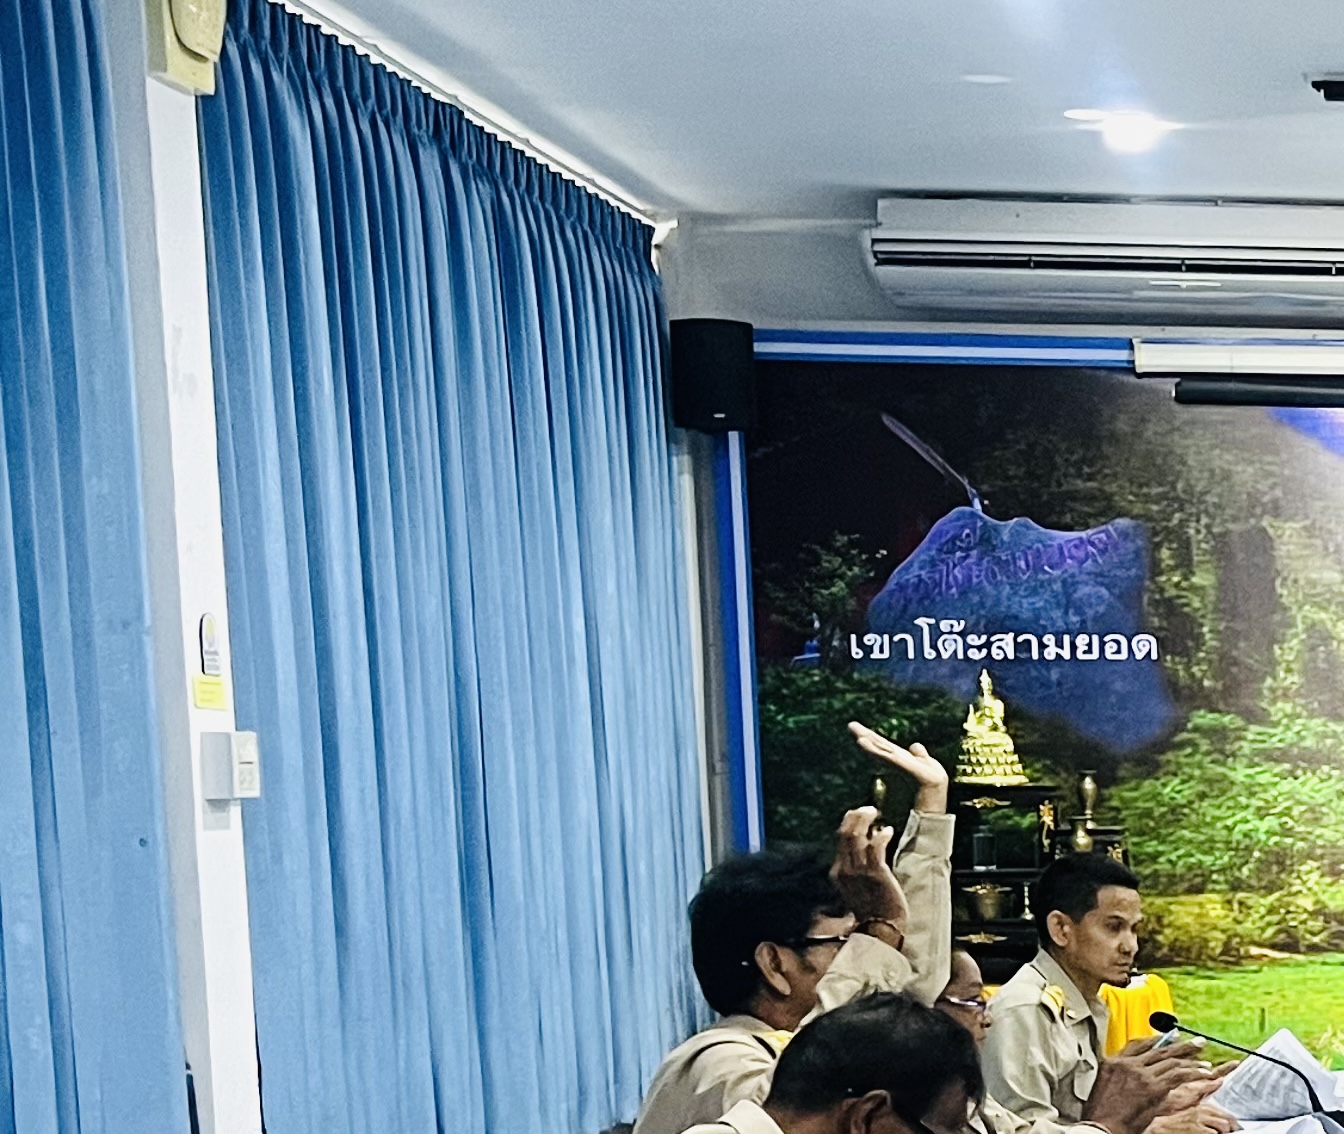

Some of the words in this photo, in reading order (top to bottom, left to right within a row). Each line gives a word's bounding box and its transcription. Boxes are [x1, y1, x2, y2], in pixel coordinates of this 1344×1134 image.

[850, 616, 1159, 660] เขาโต๊ะสามยอด
